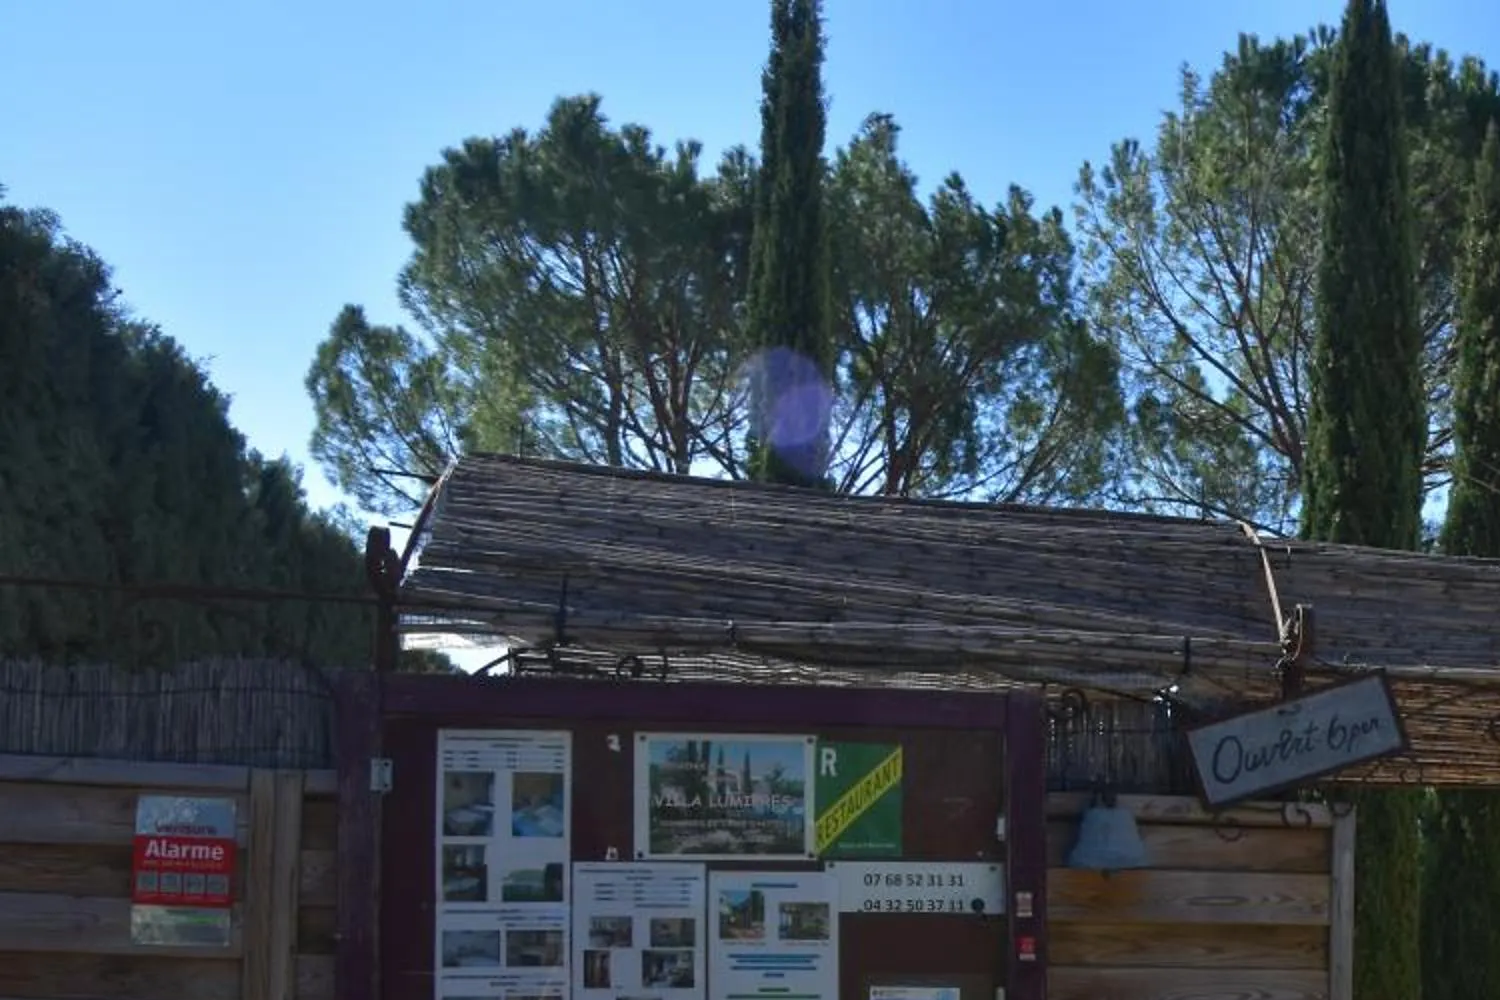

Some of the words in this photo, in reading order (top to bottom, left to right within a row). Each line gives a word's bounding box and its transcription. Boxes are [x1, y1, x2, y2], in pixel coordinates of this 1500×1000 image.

[819, 747, 838, 777] R
[144, 838, 225, 861] Alarme
[863, 873, 881, 887] 07
[885, 873, 901, 887] 68
[906, 873, 923, 887] 52
[927, 873, 943, 887] 31
[948, 873, 964, 887] 31
[863, 899, 881, 912] 04
[885, 899, 901, 912] 32
[906, 899, 924, 912] 50
[927, 899, 944, 912] 37
[949, 899, 964, 912] 11
